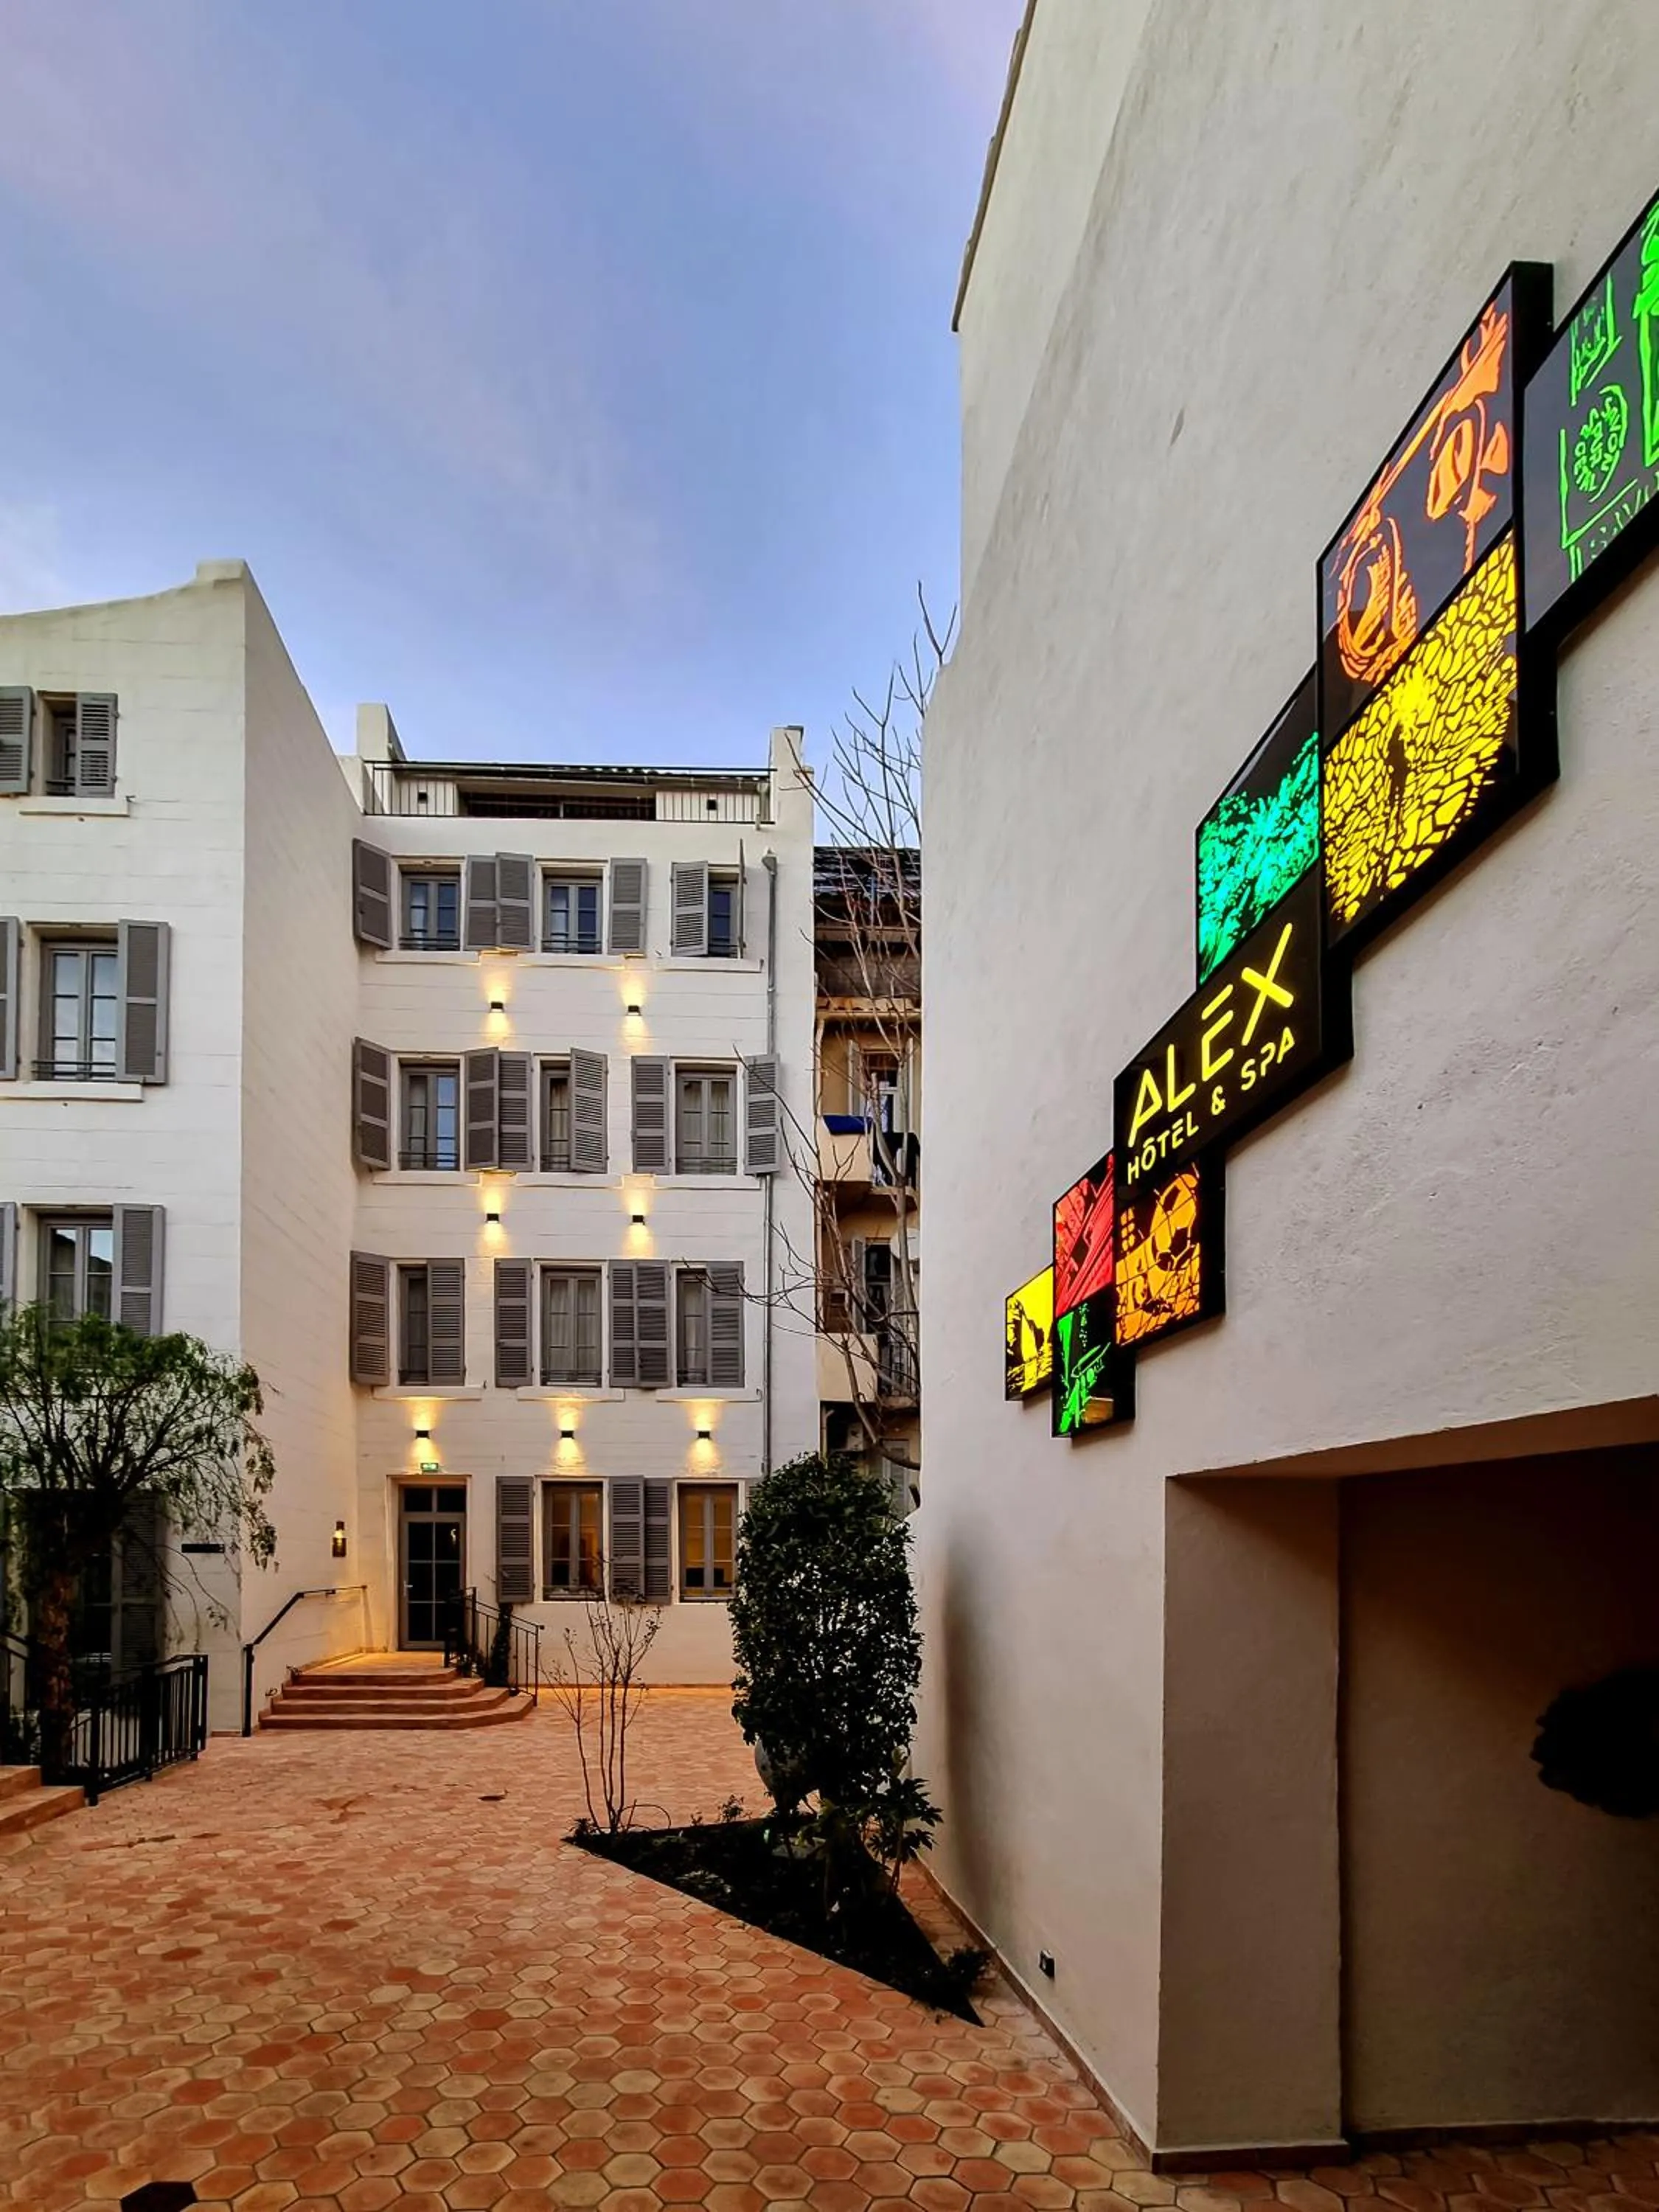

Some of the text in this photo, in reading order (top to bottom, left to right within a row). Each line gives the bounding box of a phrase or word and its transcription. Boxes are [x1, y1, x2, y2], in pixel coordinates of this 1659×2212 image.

[1589, 421, 1603, 468] PUR
[1601, 397, 1621, 472] SAVON
[1127, 922, 1294, 1147] ALEX
[1127, 1026, 1295, 1184] HÔTEL & SPA
